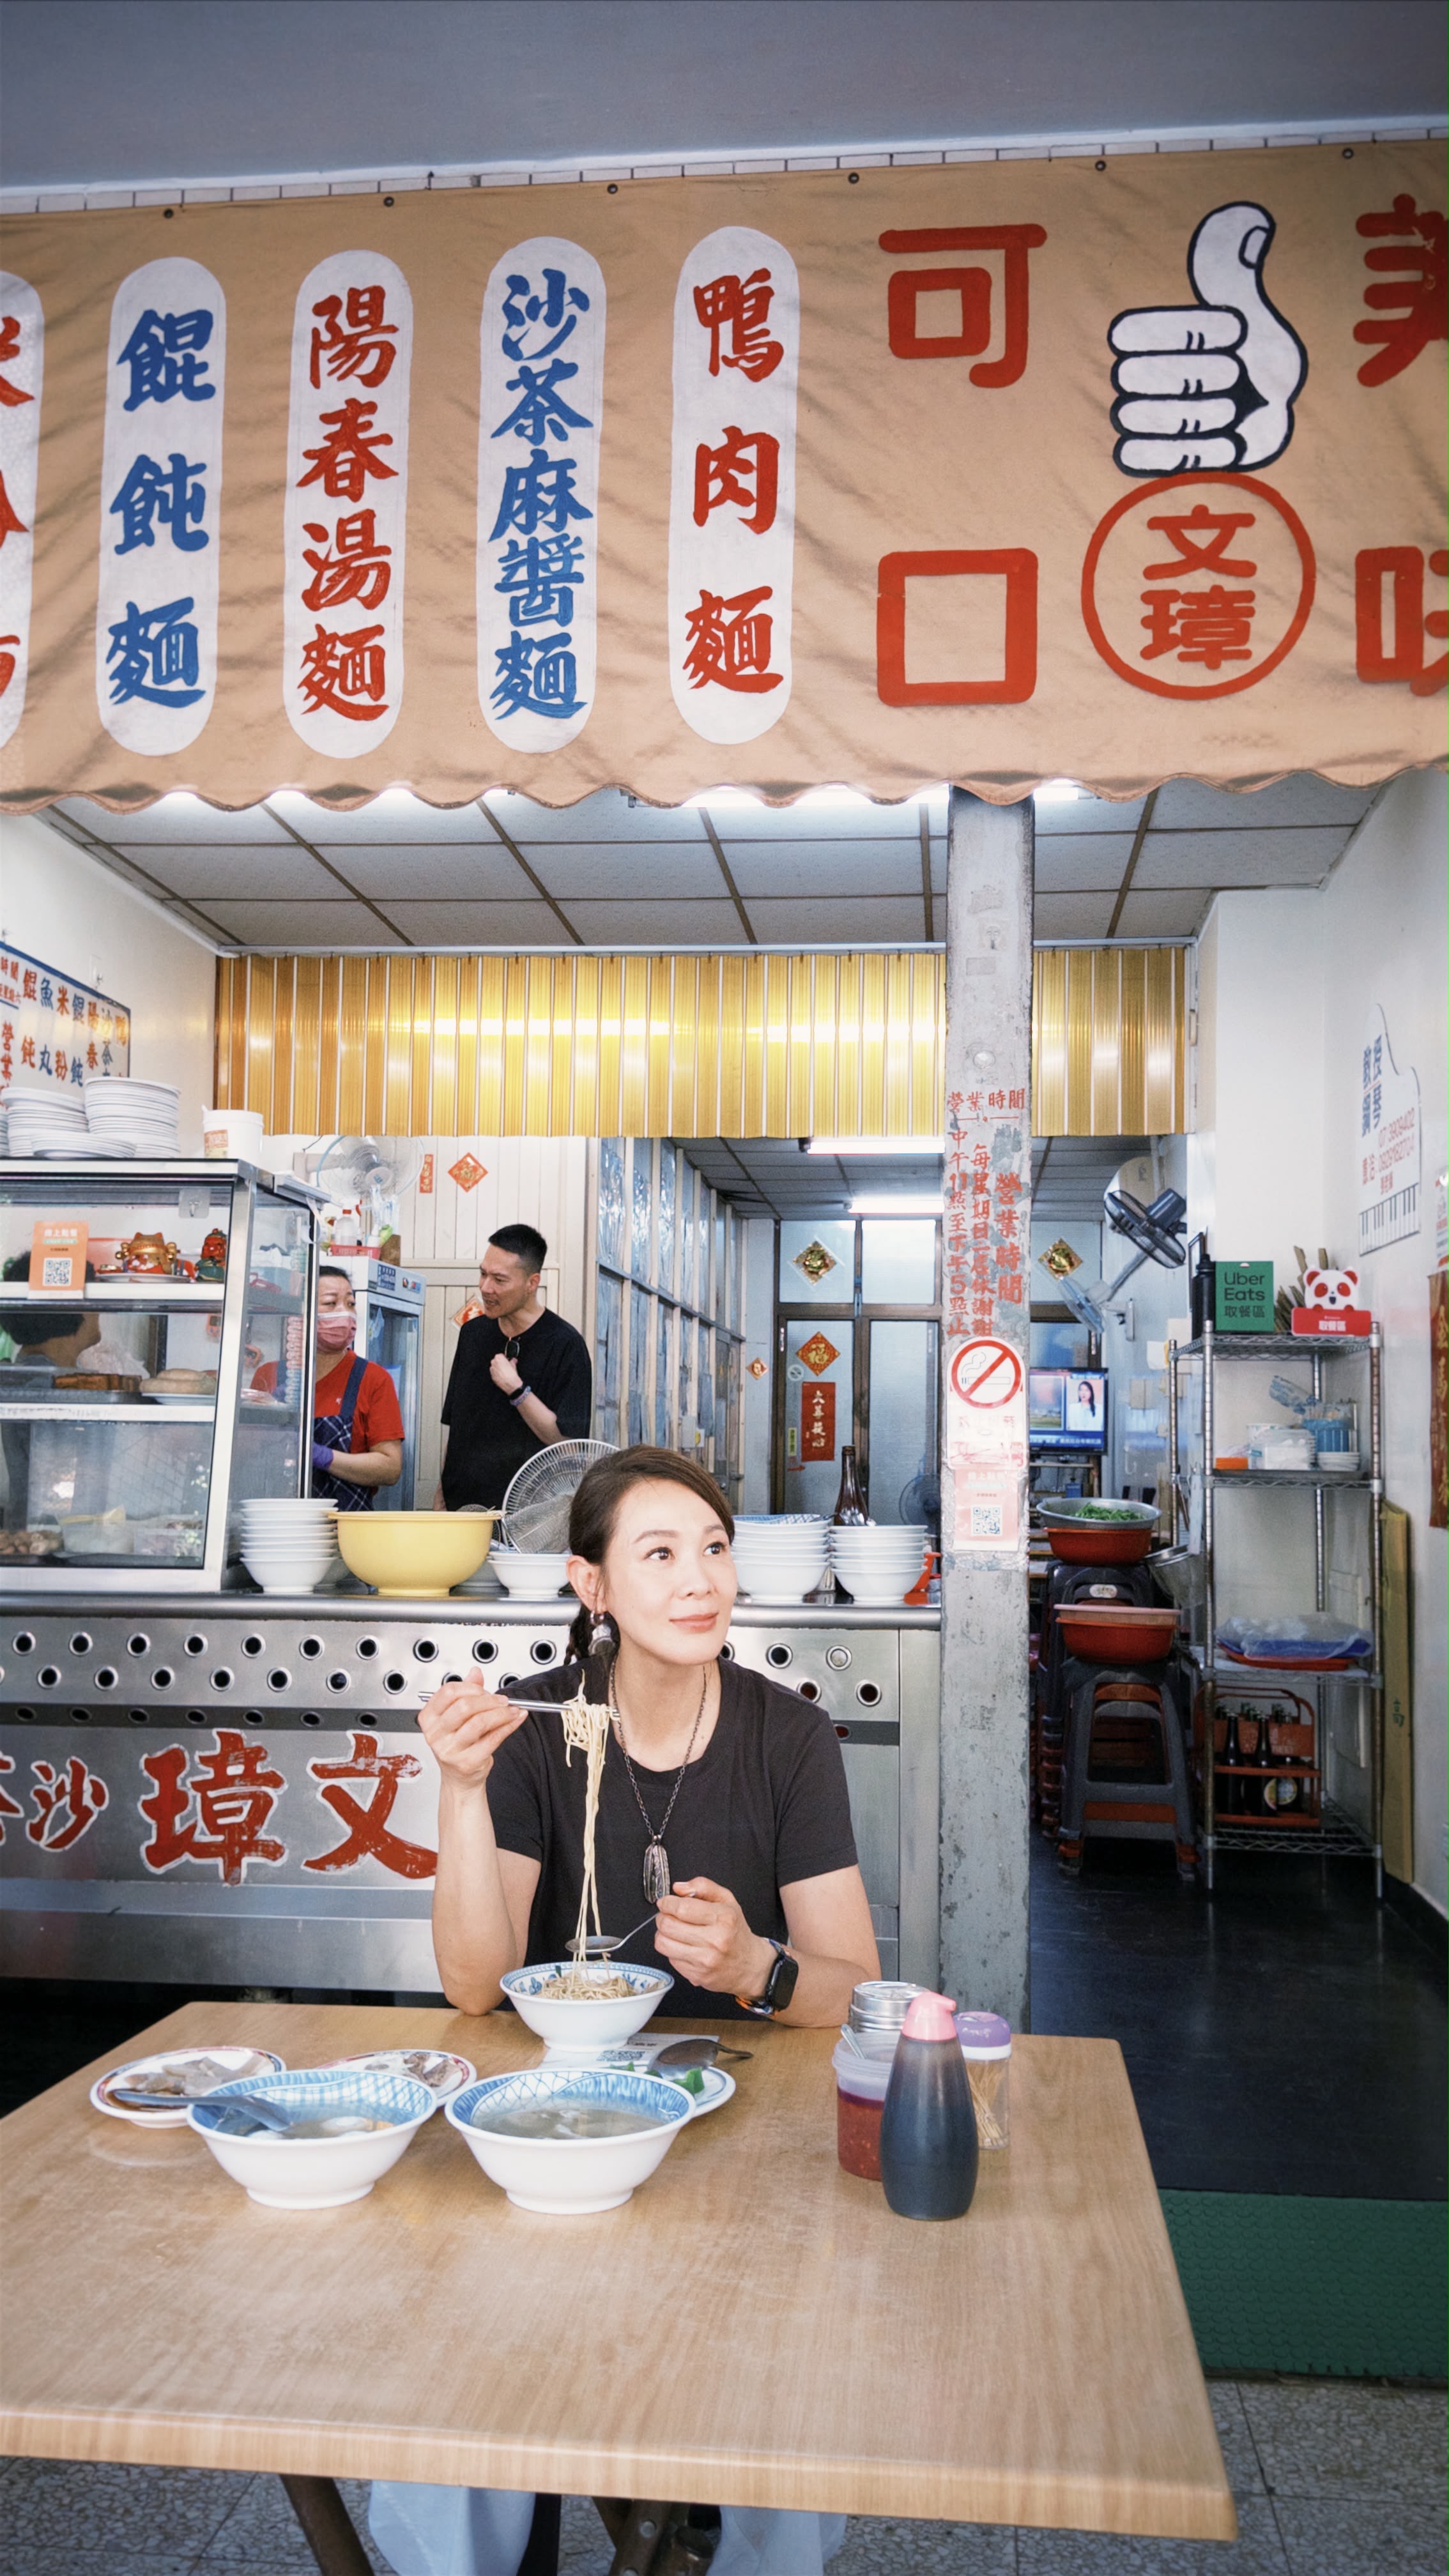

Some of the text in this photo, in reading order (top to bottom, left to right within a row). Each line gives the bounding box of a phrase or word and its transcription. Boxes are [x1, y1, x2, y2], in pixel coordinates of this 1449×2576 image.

[107, 309, 216, 708] 餛飩麵
[296, 285, 399, 721] 陽春湯麵
[489, 268, 594, 720] 沙茶麻醬麵
[682, 268, 784, 694] 鴨肉麵
[877, 224, 1047, 708] 可口
[1140, 504, 1257, 670] 文璋
[38, 977, 54, 1076] 魚丸
[54, 986, 70, 1081] 米粉
[946, 1088, 1025, 1113] 營業時間
[994, 1171, 1023, 1304] 營業時間
[1223, 1272, 1266, 1285] Uber
[1223, 1287, 1266, 1301] Eats
[808, 1343, 829, 1365] 福
[1224, 1305, 1266, 1318] 取餐區
